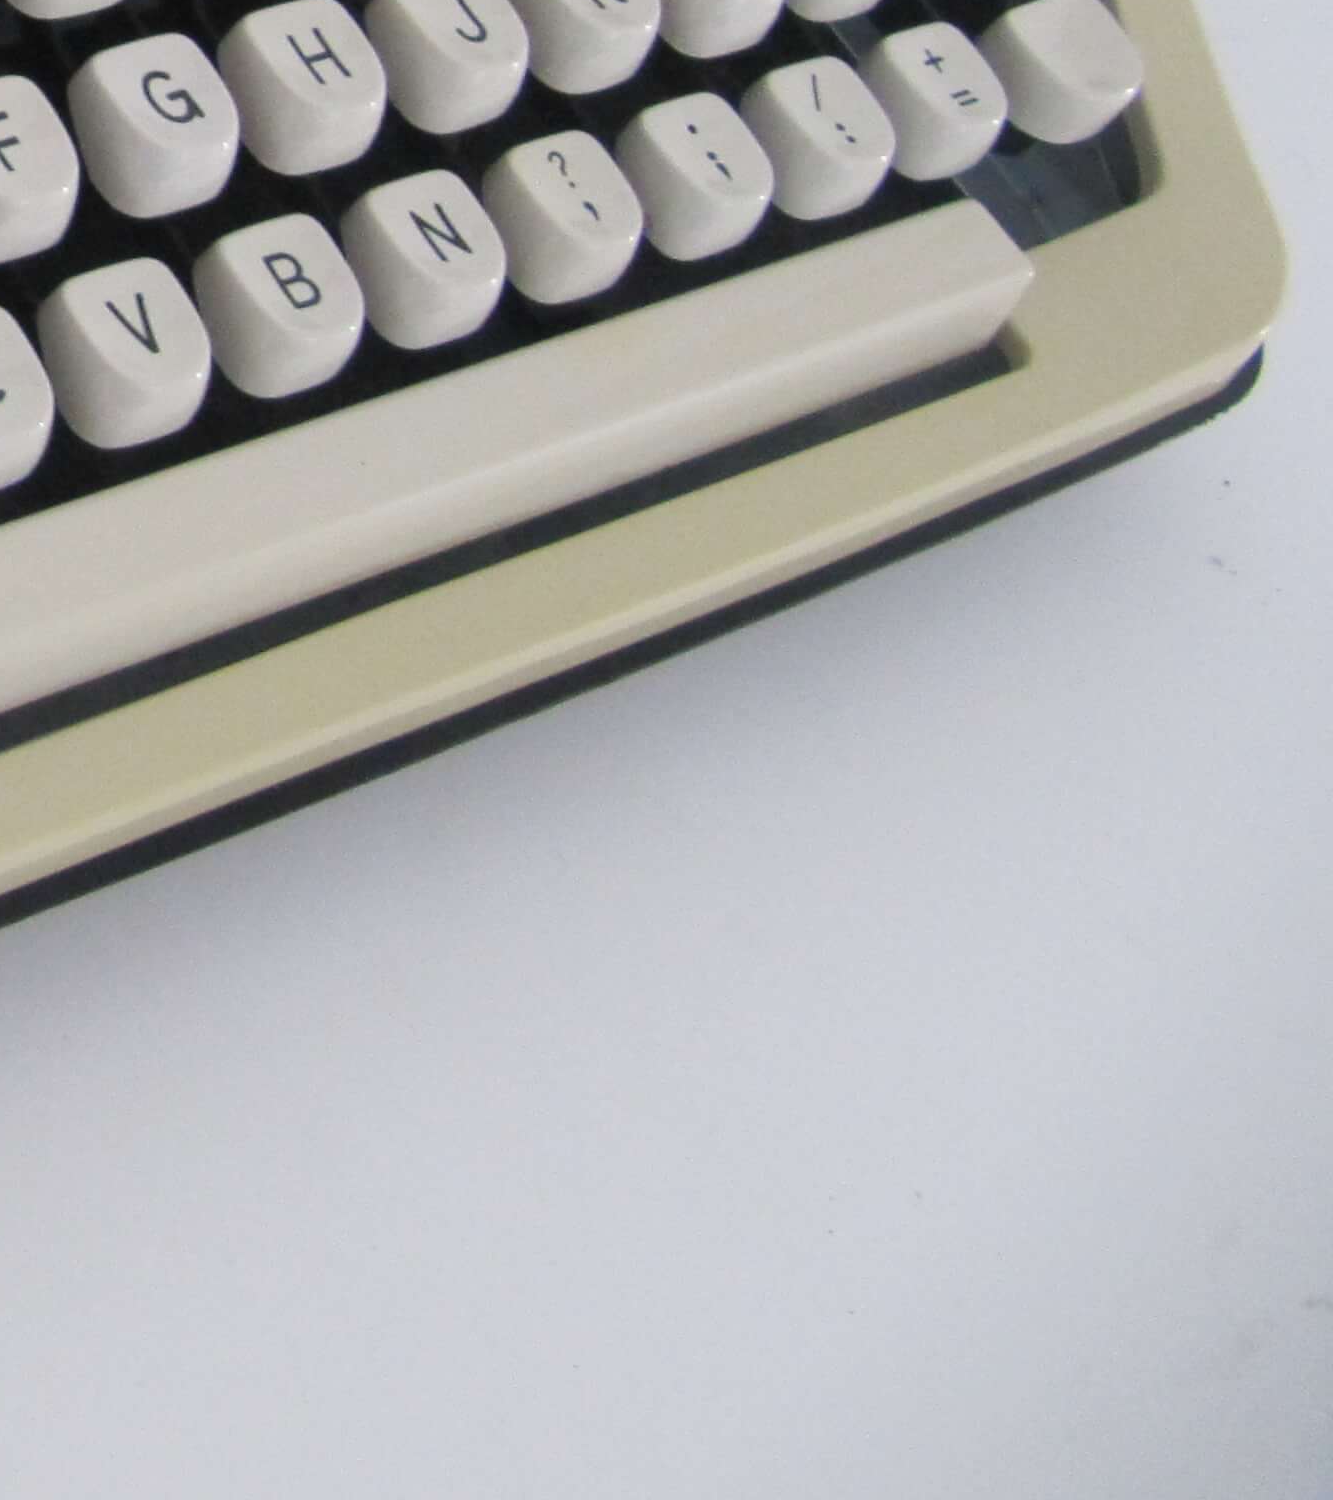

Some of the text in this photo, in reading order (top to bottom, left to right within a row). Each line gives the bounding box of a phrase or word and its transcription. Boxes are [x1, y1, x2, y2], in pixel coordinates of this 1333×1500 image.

[142, 70, 206, 124] G
[286, 27, 352, 85] H
[105, 292, 160, 354] V
[262, 252, 322, 310] B
[408, 202, 474, 263] N
[547, 150, 576, 189] ?
